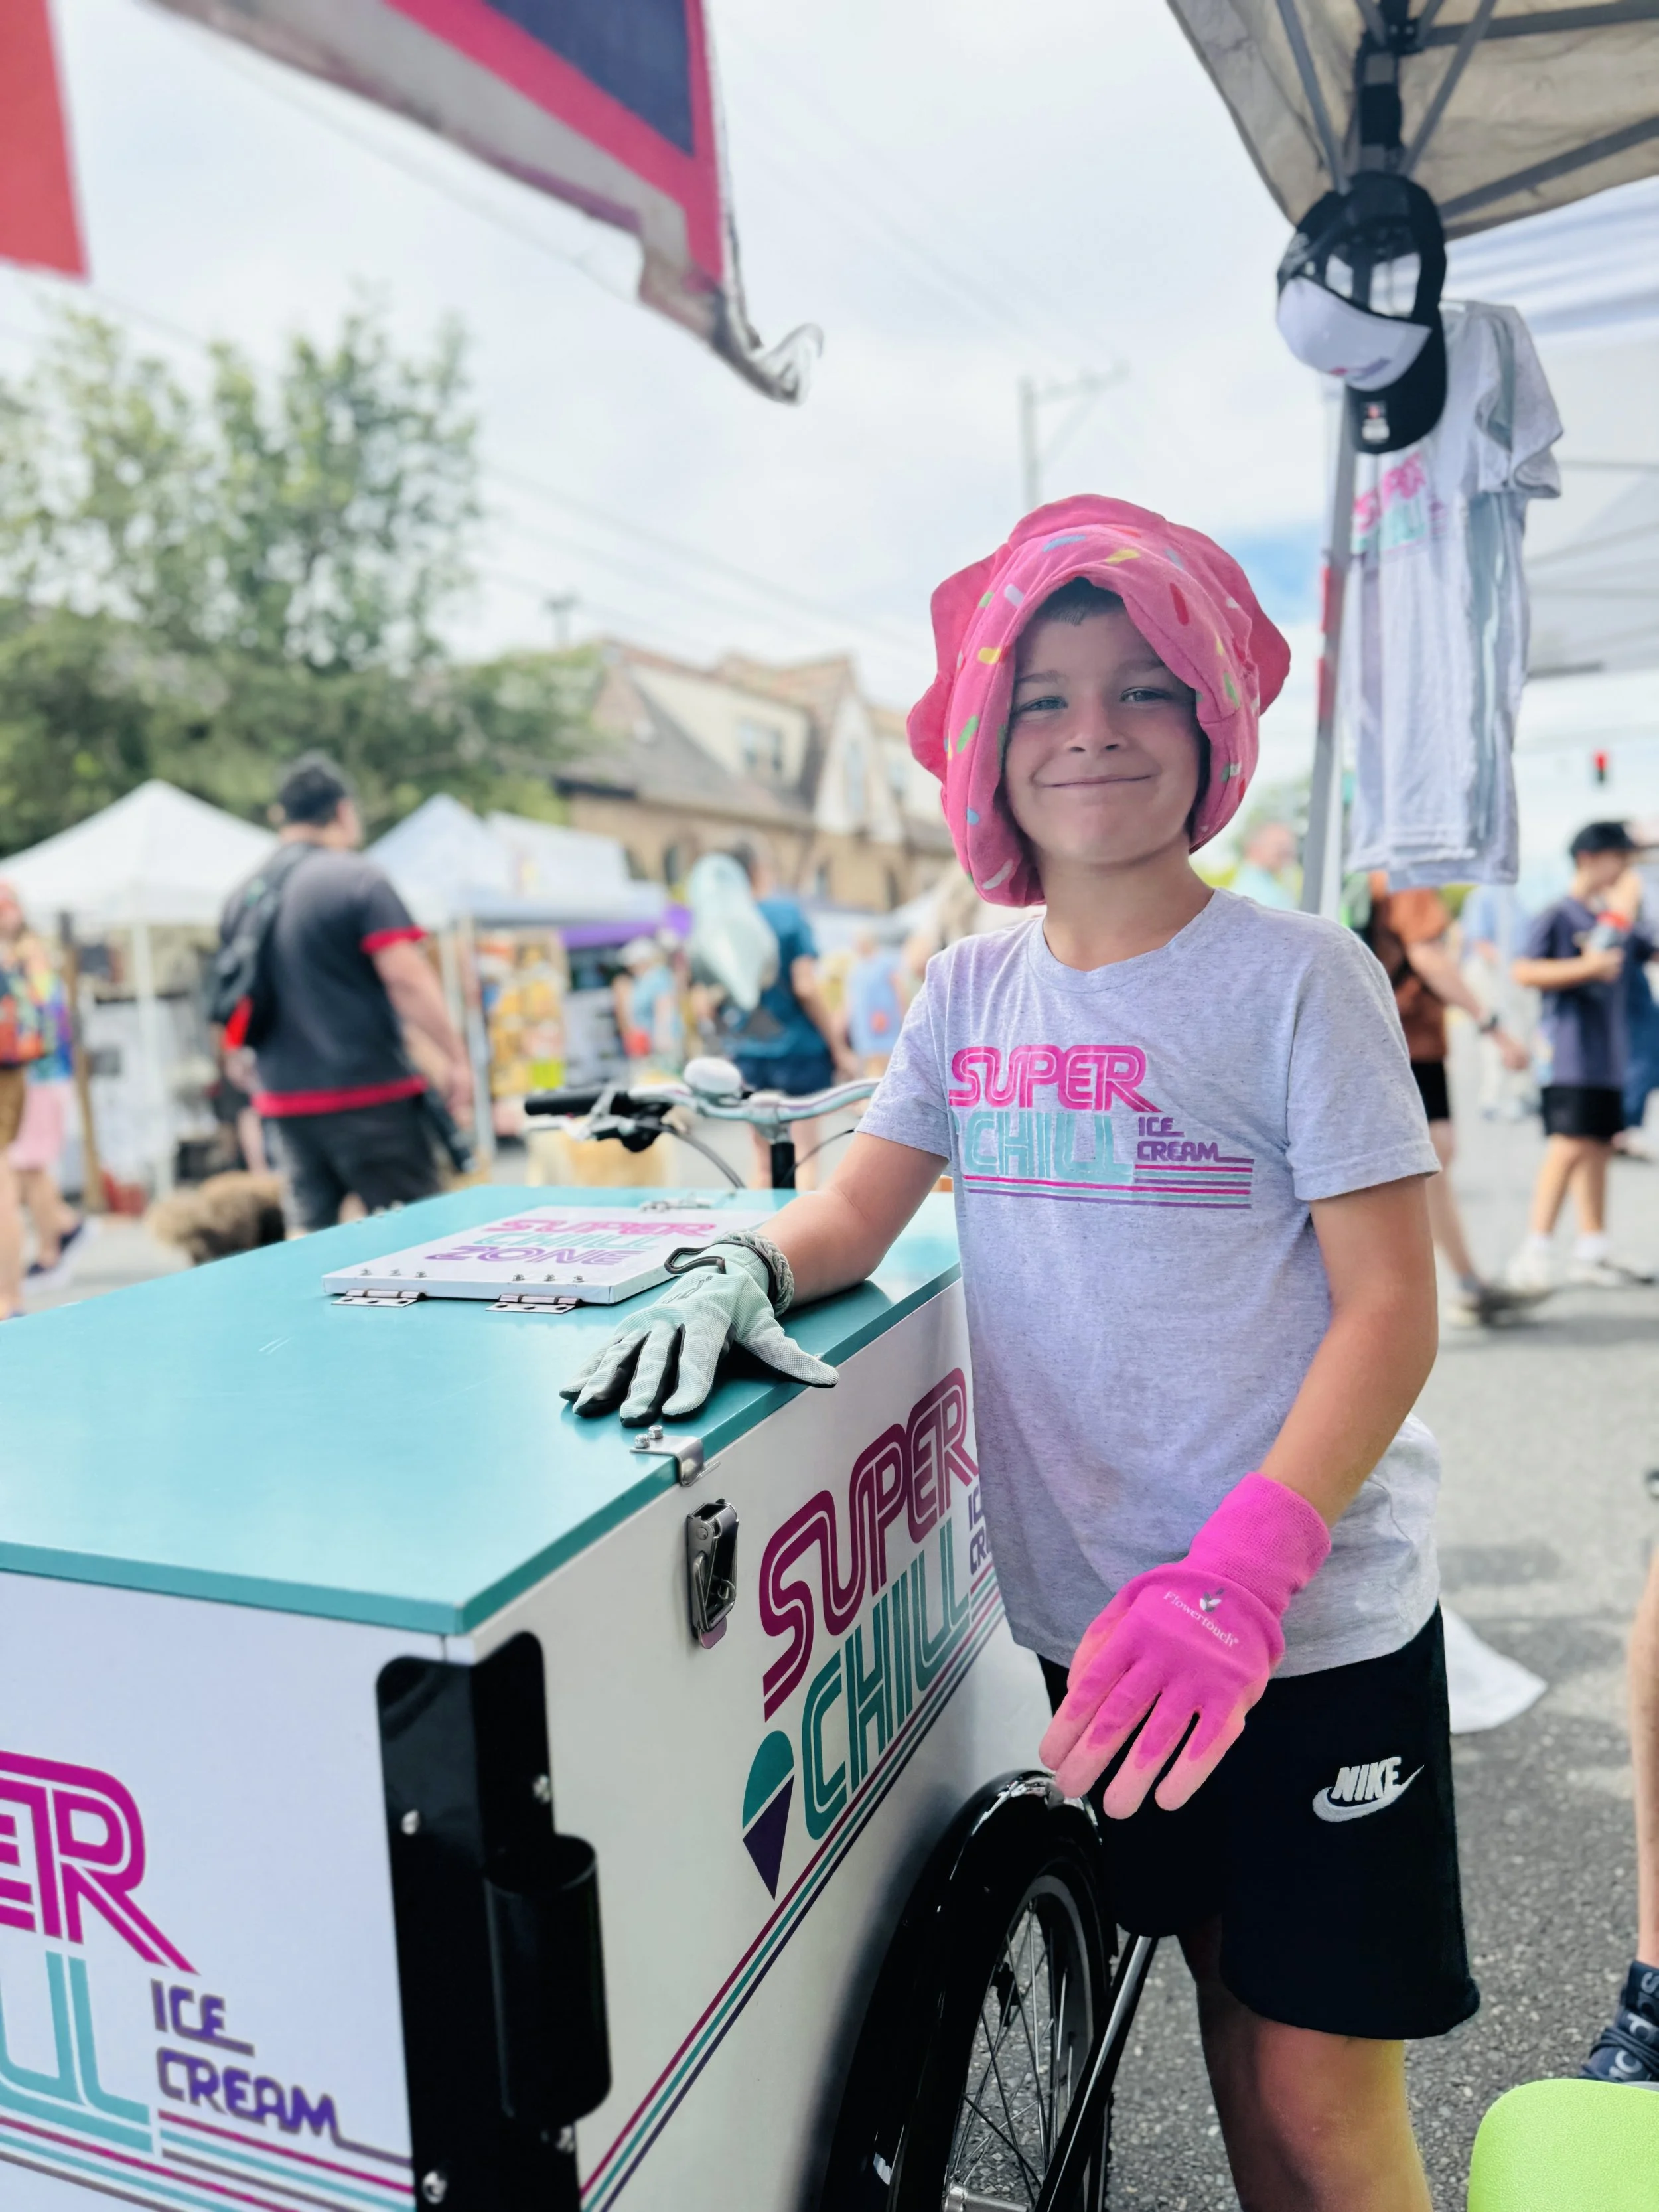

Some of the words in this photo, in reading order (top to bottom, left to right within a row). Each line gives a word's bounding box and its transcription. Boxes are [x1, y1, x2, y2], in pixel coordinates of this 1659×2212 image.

[949, 1044, 1163, 1113] SUPER
[964, 1111, 1133, 1184] CHILL
[1138, 1116, 1185, 1137] ICE
[1137, 1140, 1254, 1164] CREAM
[474, 1233, 662, 1250] CHILL
[484, 1220, 716, 1236] SUPER
[424, 1245, 648, 1265] ZONE
[968, 1485, 982, 1532] IC
[760, 1367, 979, 1722] SUPER
[801, 1517, 970, 1840] CHILL
[1330, 1756, 1402, 1801] NIKE
[151, 1978, 255, 2057] ICE
[155, 2046, 413, 2168] CREAM
